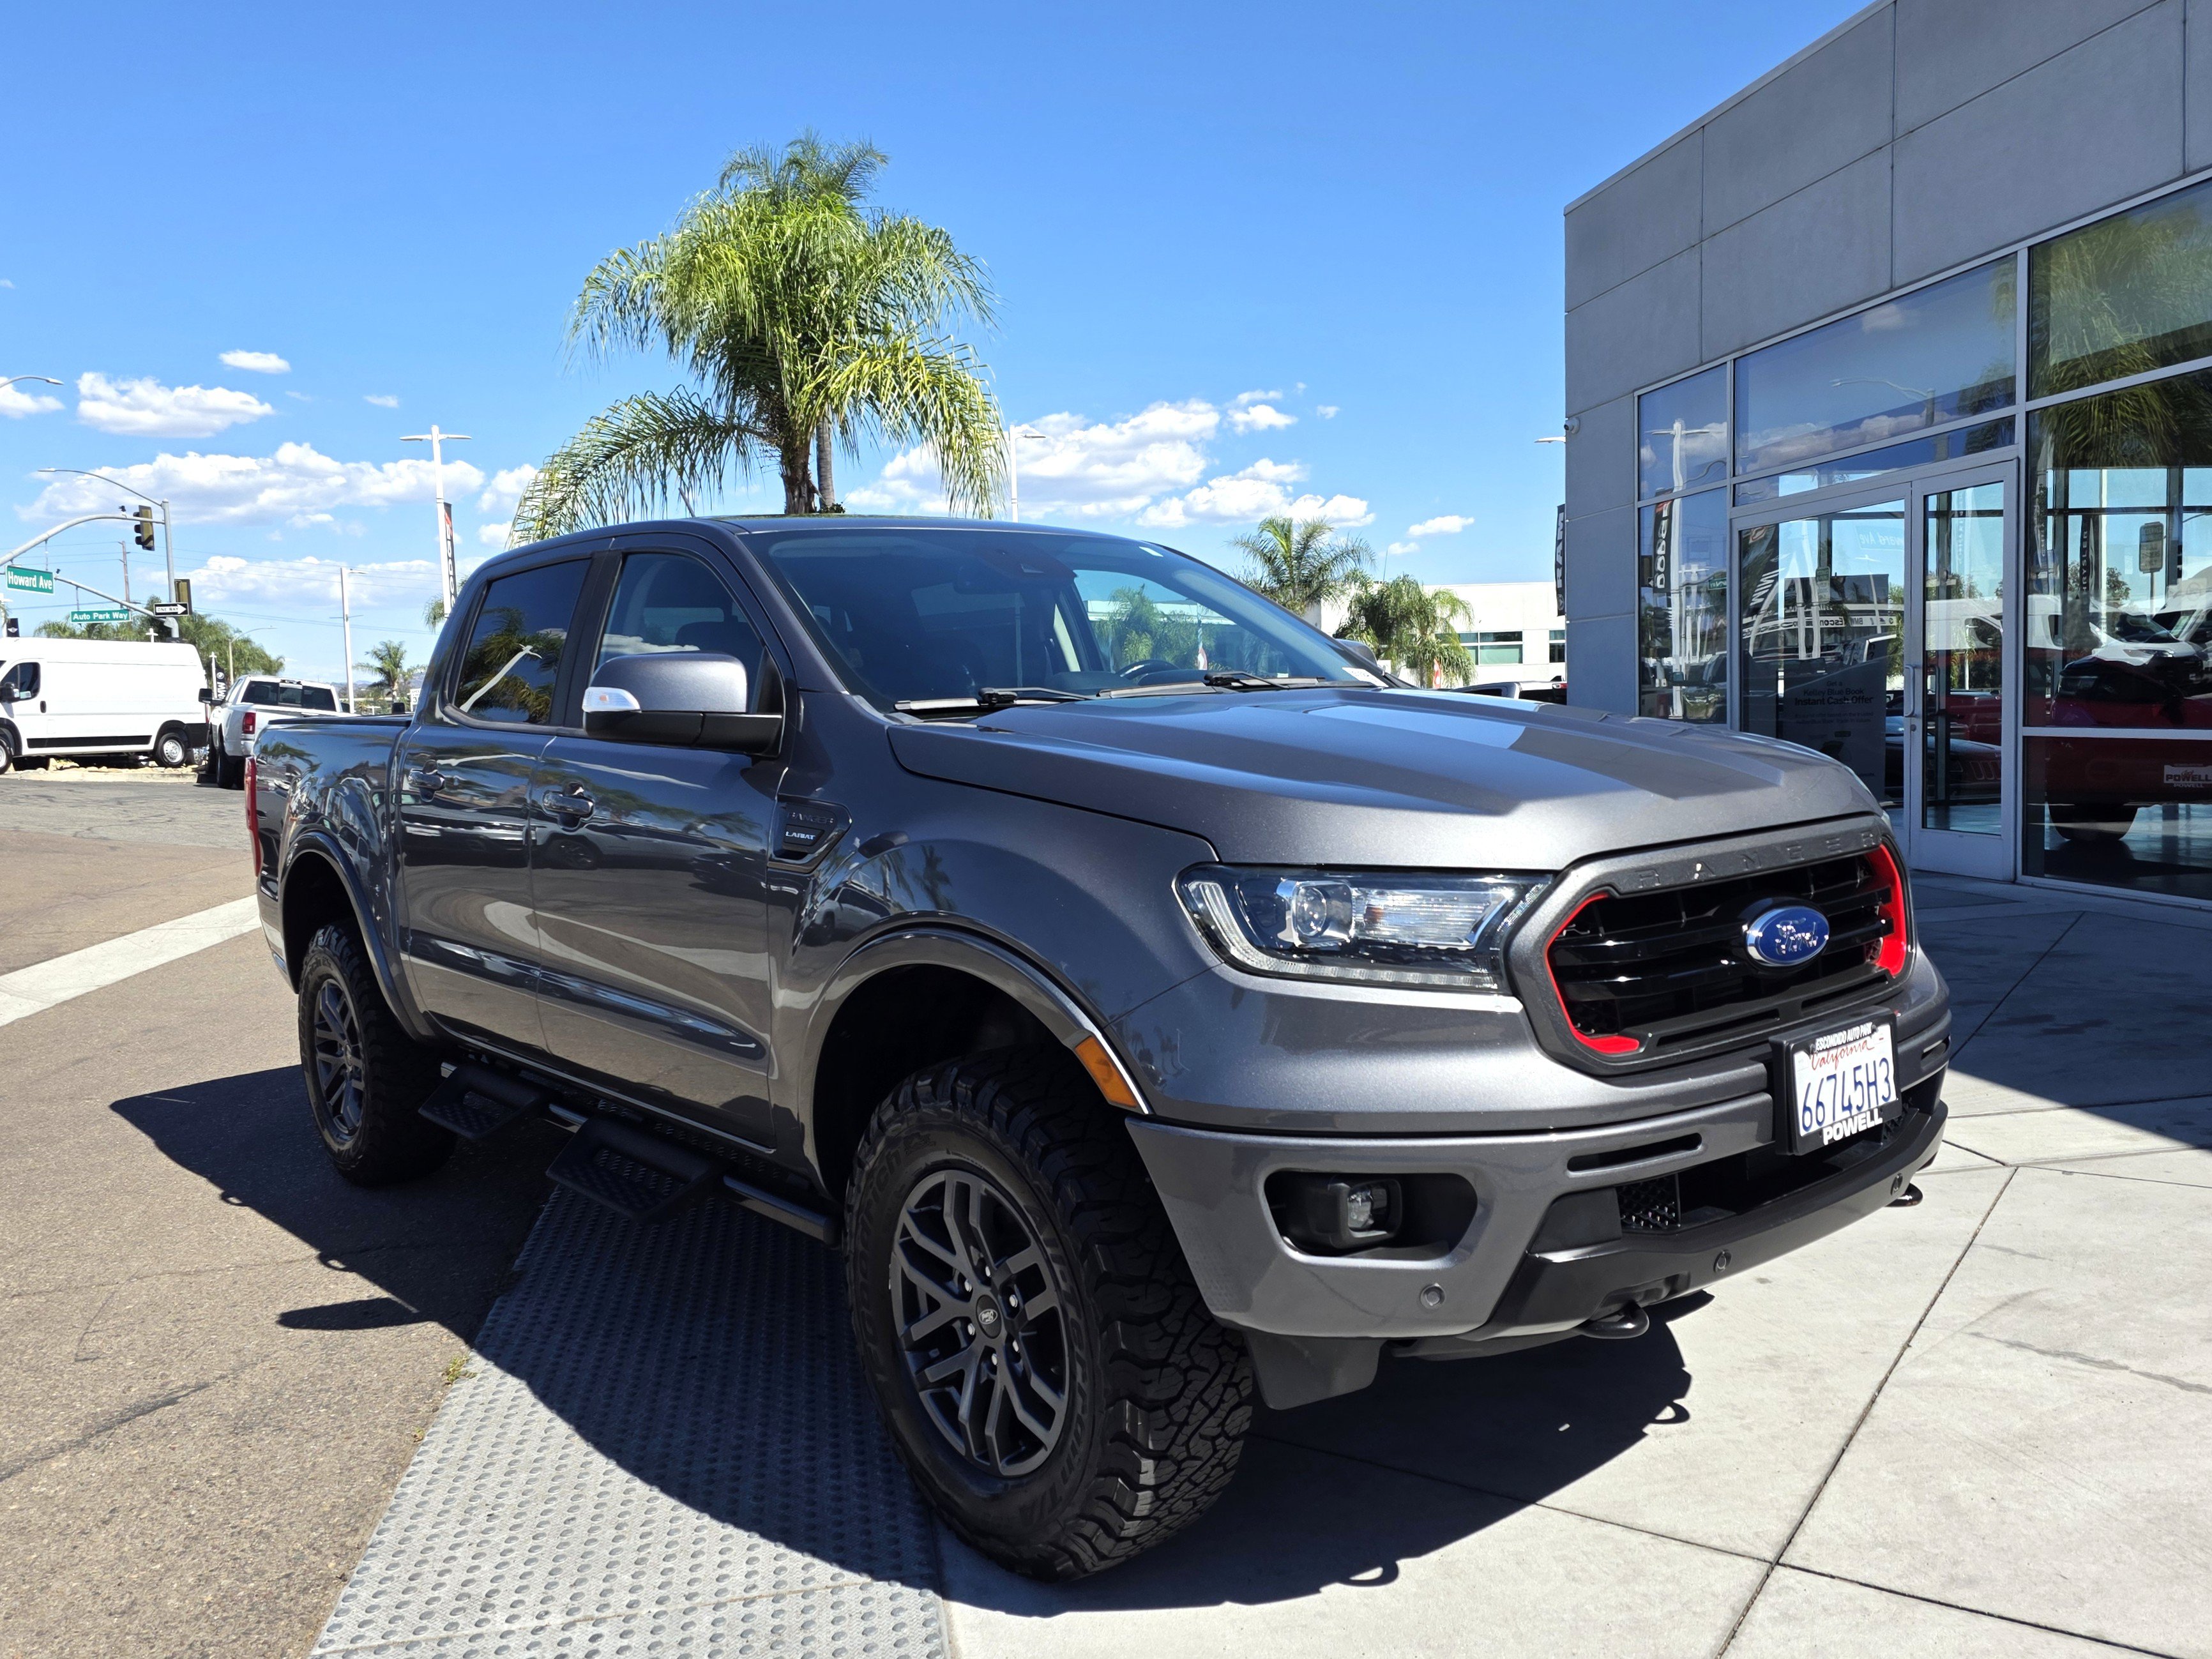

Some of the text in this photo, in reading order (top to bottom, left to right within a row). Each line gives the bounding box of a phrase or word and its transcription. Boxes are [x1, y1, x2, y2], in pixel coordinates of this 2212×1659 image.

[1556, 511, 1564, 588] RAM
[8, 571, 53, 589] Howard Ave
[112, 611, 128, 620] Way
[1795, 695, 1874, 706] Instant Cash Offer
[1636, 831, 1876, 887] RANGER
[1775, 917, 1818, 955] Ford
[1815, 1021, 1873, 1052] ESCONDIDO AUTO PARK
[1810, 1039, 1875, 1071] California
[1801, 1057, 1891, 1133] 66745H3
[1822, 1108, 1883, 1146] POWELL
